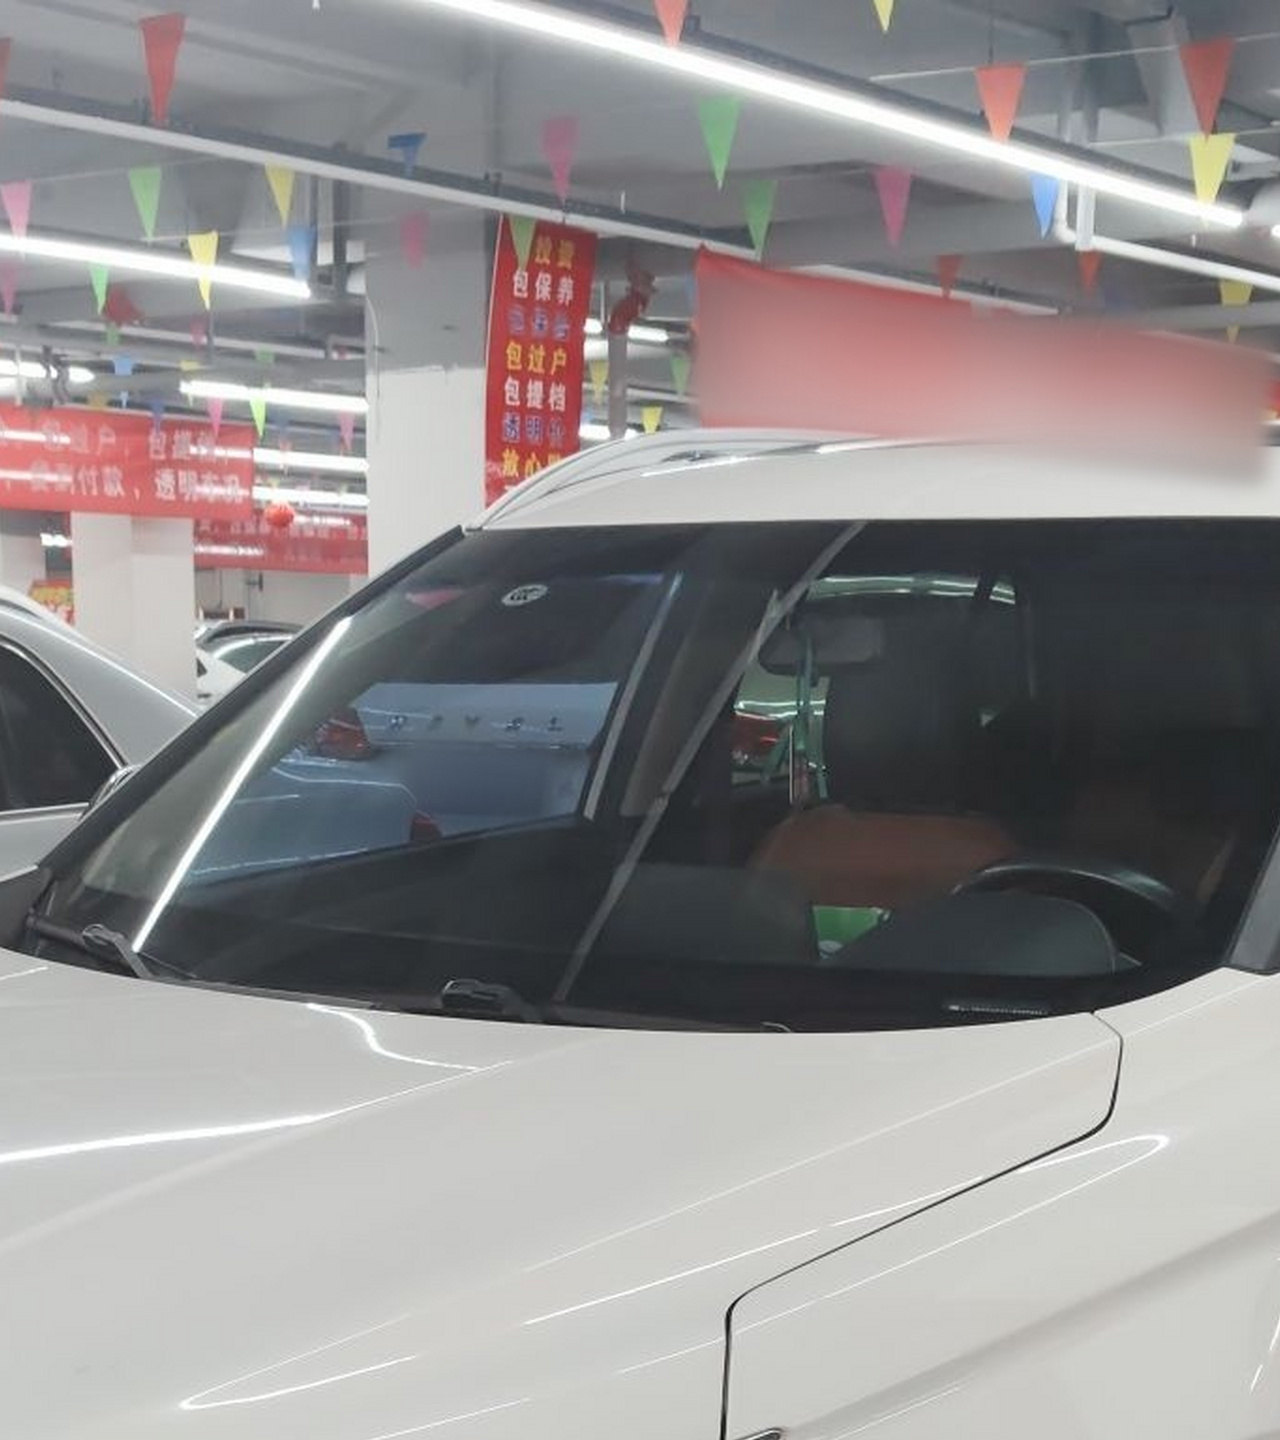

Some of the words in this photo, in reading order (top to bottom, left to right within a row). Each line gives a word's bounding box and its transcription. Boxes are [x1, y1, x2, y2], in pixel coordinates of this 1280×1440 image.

[512, 269, 575, 306] 包保养
[506, 342, 567, 375] 包过户
[504, 376, 566, 412] 包提档
